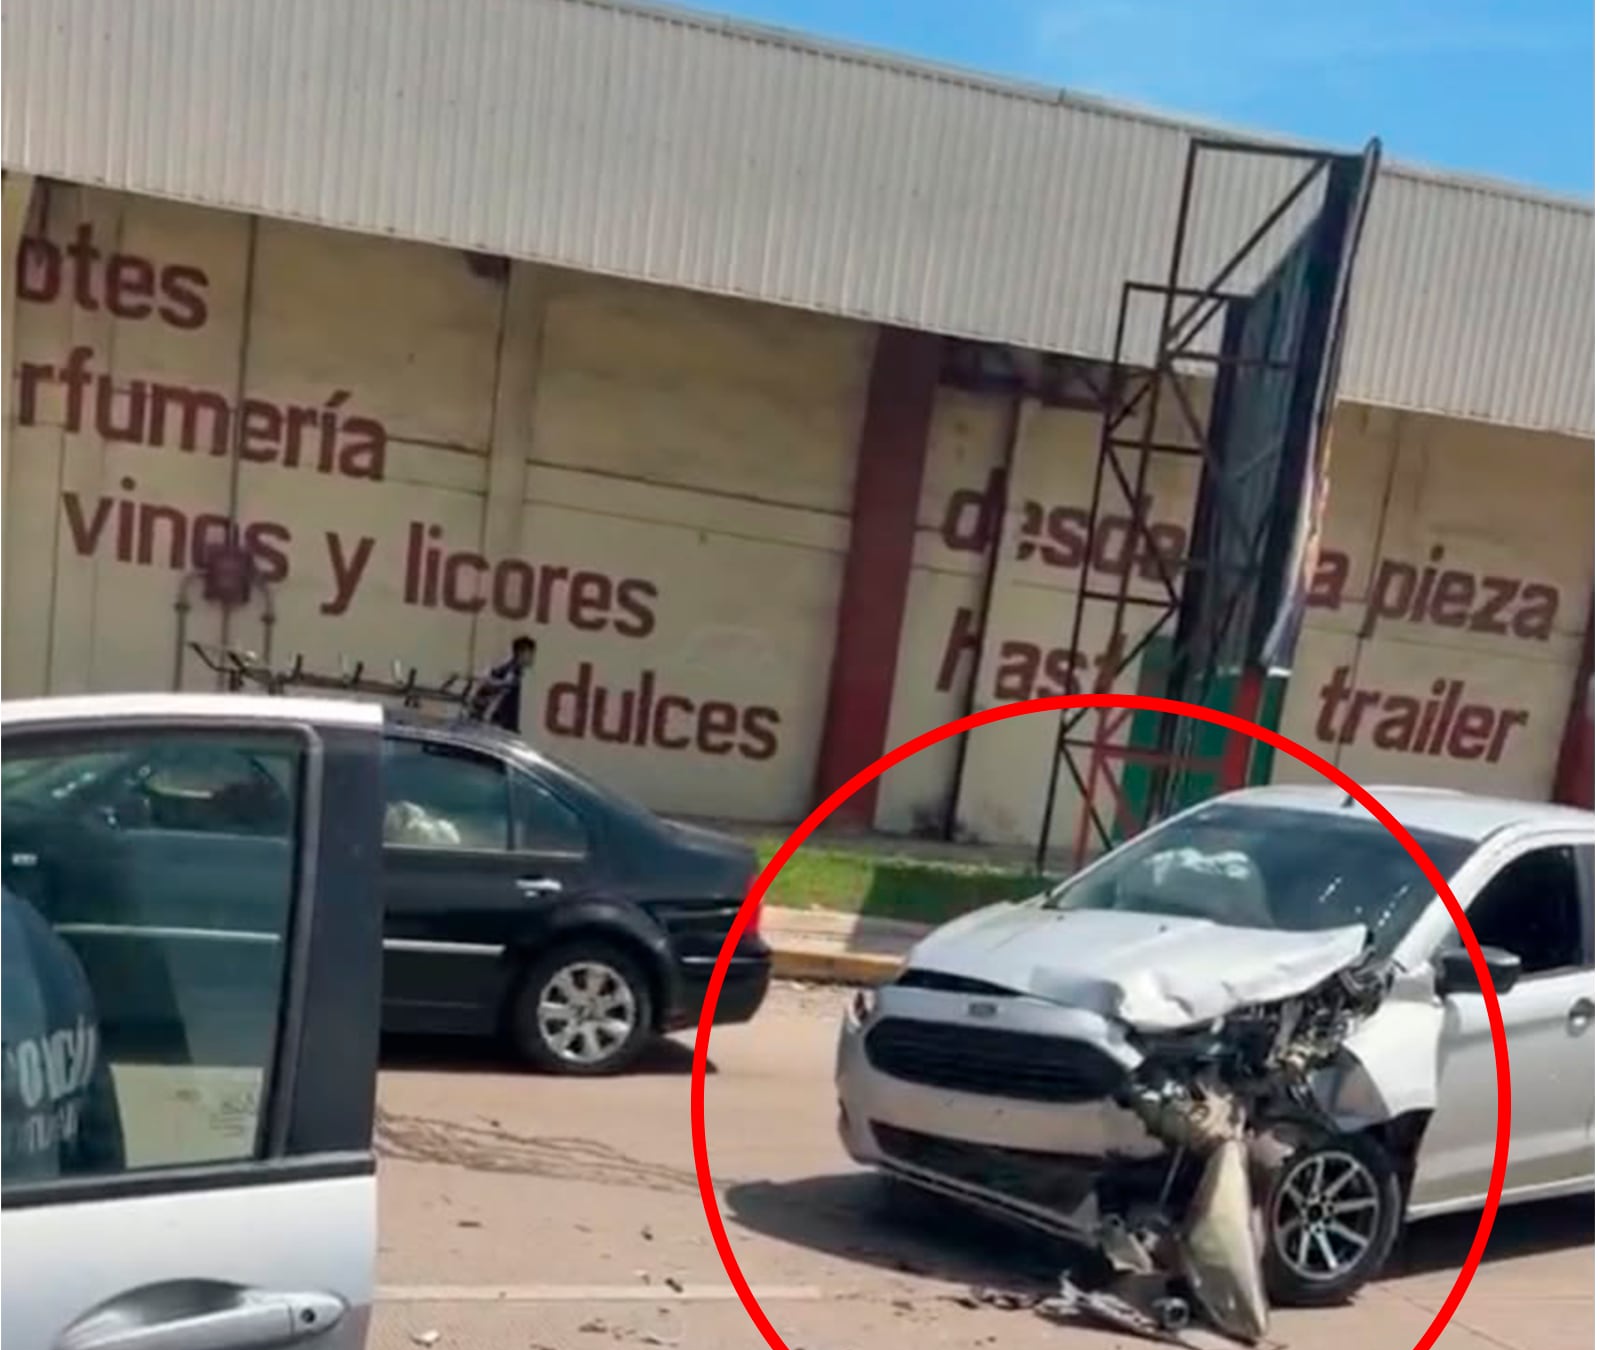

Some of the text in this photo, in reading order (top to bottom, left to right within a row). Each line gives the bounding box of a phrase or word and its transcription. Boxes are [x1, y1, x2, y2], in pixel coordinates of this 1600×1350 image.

[320, 530, 376, 616] y
[404, 521, 659, 638] licores
[1358, 544, 1560, 642] pieza
[545, 662, 781, 761] dulces
[1315, 665, 1530, 764] trailer
